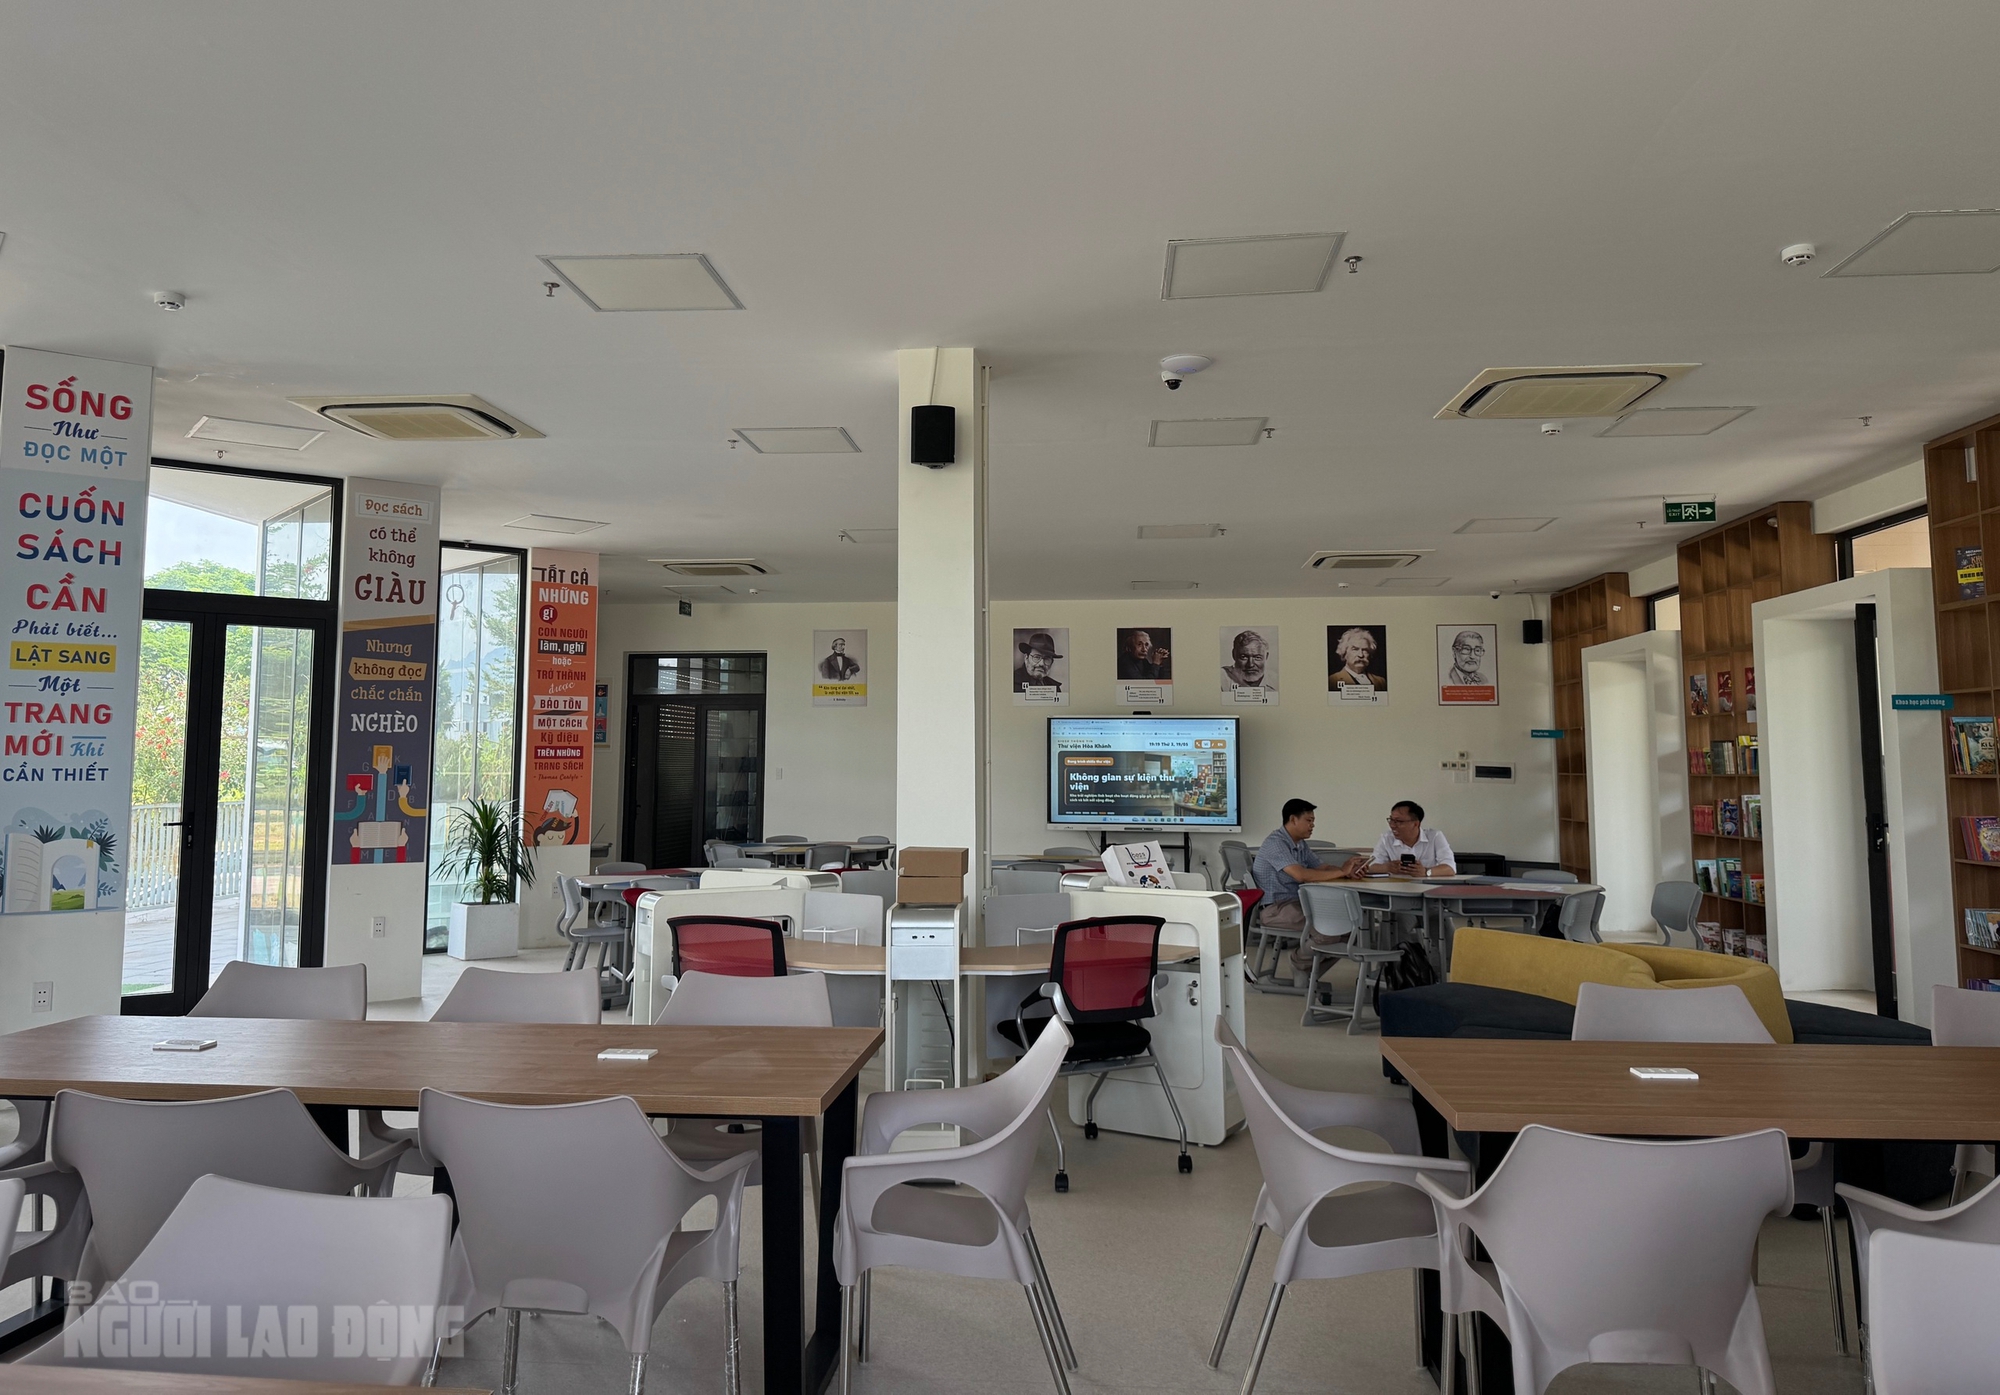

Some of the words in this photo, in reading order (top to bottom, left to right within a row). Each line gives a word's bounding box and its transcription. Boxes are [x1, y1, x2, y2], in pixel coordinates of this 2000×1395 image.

[25, 375, 133, 420] SỐNG
[53, 420, 99, 440] Như
[23, 441, 71, 463] ĐỌC
[80, 445, 127, 470] MỘT
[19, 485, 125, 526] CUỐN
[365, 499, 389, 514] Đọc
[392, 502, 423, 517] sách
[369, 527, 387, 540] có
[390, 527, 417, 543] thể
[16, 528, 122, 566] SÁCH
[369, 547, 416, 568] không
[532, 564, 566, 584] TẤT
[571, 567, 589, 586] CẢ
[26, 572, 108, 613] CẦN
[355, 571, 426, 605] GIÀU
[539, 586, 589, 605] NHỮNG
[543, 607, 554, 621] gì
[12, 619, 59, 636] Phải
[66, 621, 117, 638] biết...
[538, 626, 557, 637] CON
[560, 628, 588, 639] NGƯỜI
[16, 645, 52, 666] LẬT
[58, 650, 111, 665] SANG
[366, 639, 413, 657] Nhưng
[563, 642, 585, 655] nghĩ
[354, 662, 395, 679] không
[398, 665, 422, 679] đọc
[552, 656, 572, 667] hoặc
[537, 668, 554, 680] TRỞ
[556, 669, 587, 681] THÀNH
[38, 675, 81, 696] Một
[351, 685, 385, 700] chắc
[389, 686, 423, 702] chắn
[548, 682, 576, 695] được
[540, 697, 559, 709] BẢO
[563, 697, 582, 710] TỒN
[4, 702, 113, 724] TRANG
[351, 710, 418, 733] NGHÈO
[537, 717, 557, 729] MỘT
[559, 717, 583, 728] CÁCH
[5, 729, 65, 757] MỚI
[70, 741, 105, 757] Khi
[556, 732, 579, 745] diệu
[537, 747, 555, 757] TRÊN
[556, 747, 581, 757] NHỮNG
[3, 761, 44, 782] CẦN
[52, 761, 109, 782] THIẾT
[534, 762, 561, 770] TRANG
[562, 761, 584, 770] SÁCH
[1070, 772, 1099, 783] Không
[1101, 773, 1121, 783] gian
[1123, 774, 1135, 783] sự
[1137, 773, 1157, 783] kiện
[1159, 773, 1175, 782] thư
[1070, 782, 1089, 792] viện
